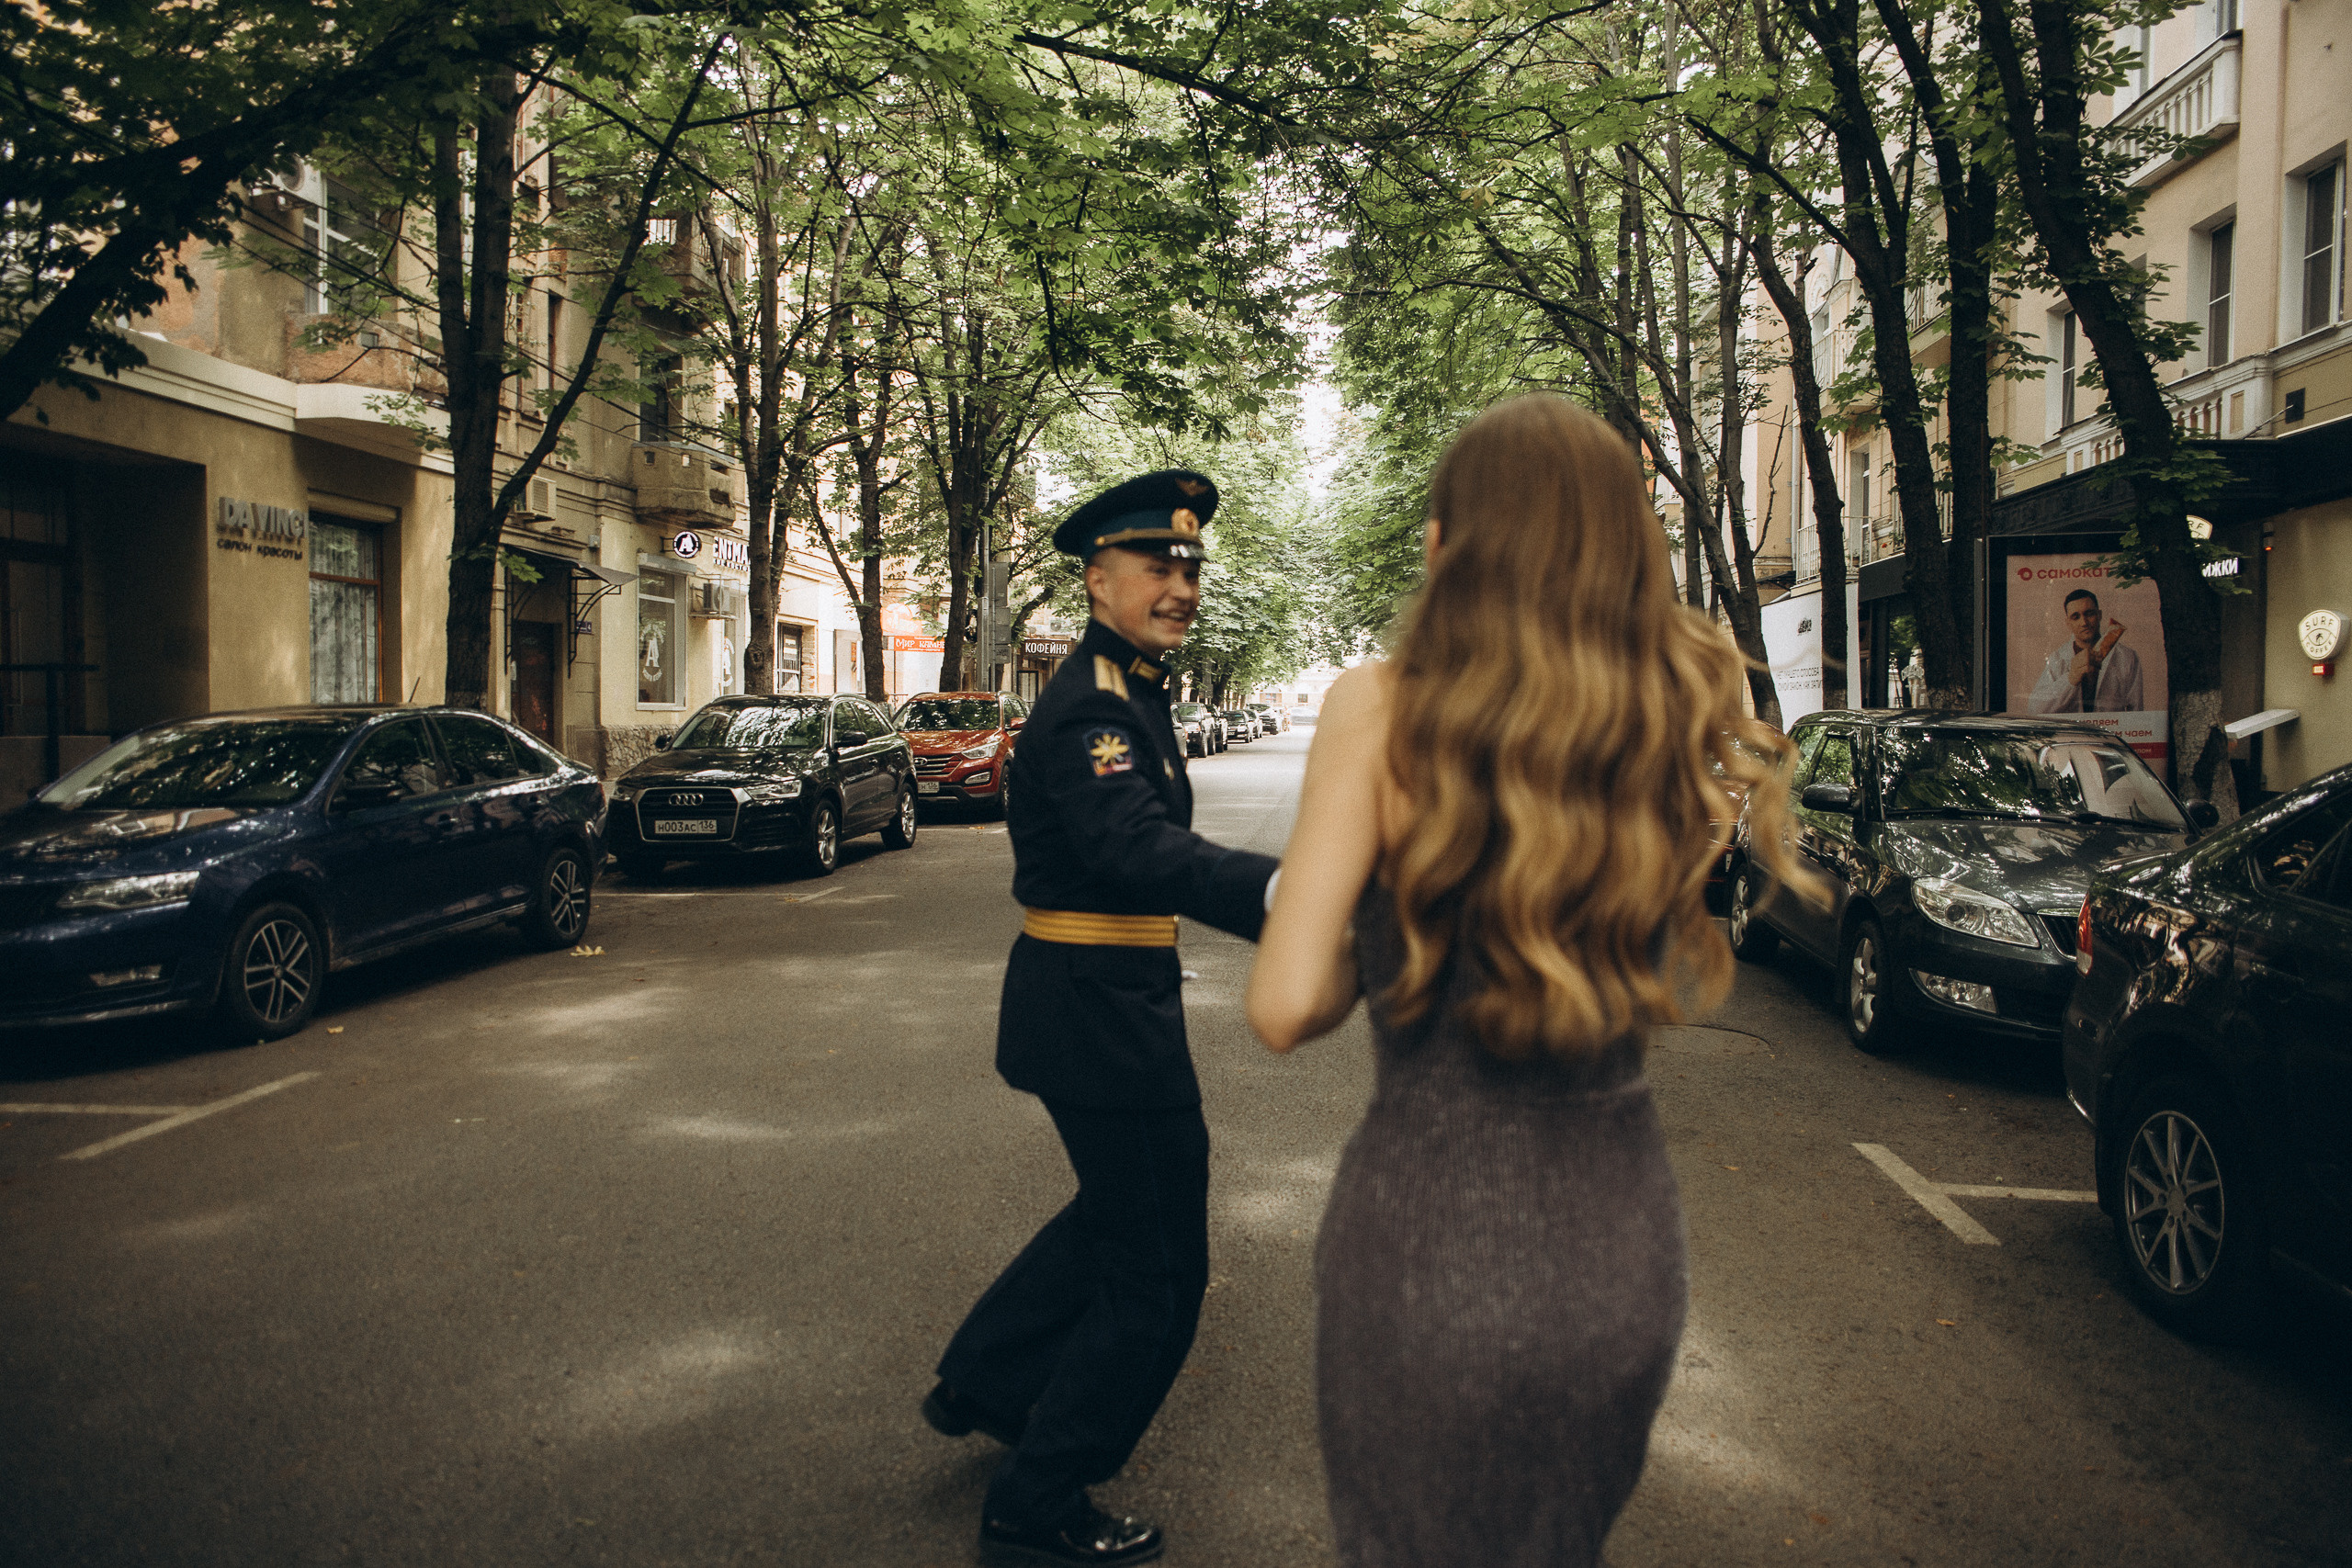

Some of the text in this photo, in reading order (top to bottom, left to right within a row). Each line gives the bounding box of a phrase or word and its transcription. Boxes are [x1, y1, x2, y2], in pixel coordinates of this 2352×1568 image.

[219, 497, 310, 539] DA VINCI
[257, 545, 303, 560] красоты
[713, 536, 751, 566] ENTMA
[2037, 567, 2111, 580] самокат
[2201, 557, 2239, 578] ИЖКИ
[2306, 615, 2335, 631] SURF
[1025, 642, 1068, 655] КОФЕЙНЯ
[659, 820, 714, 832] Н003АС 136
